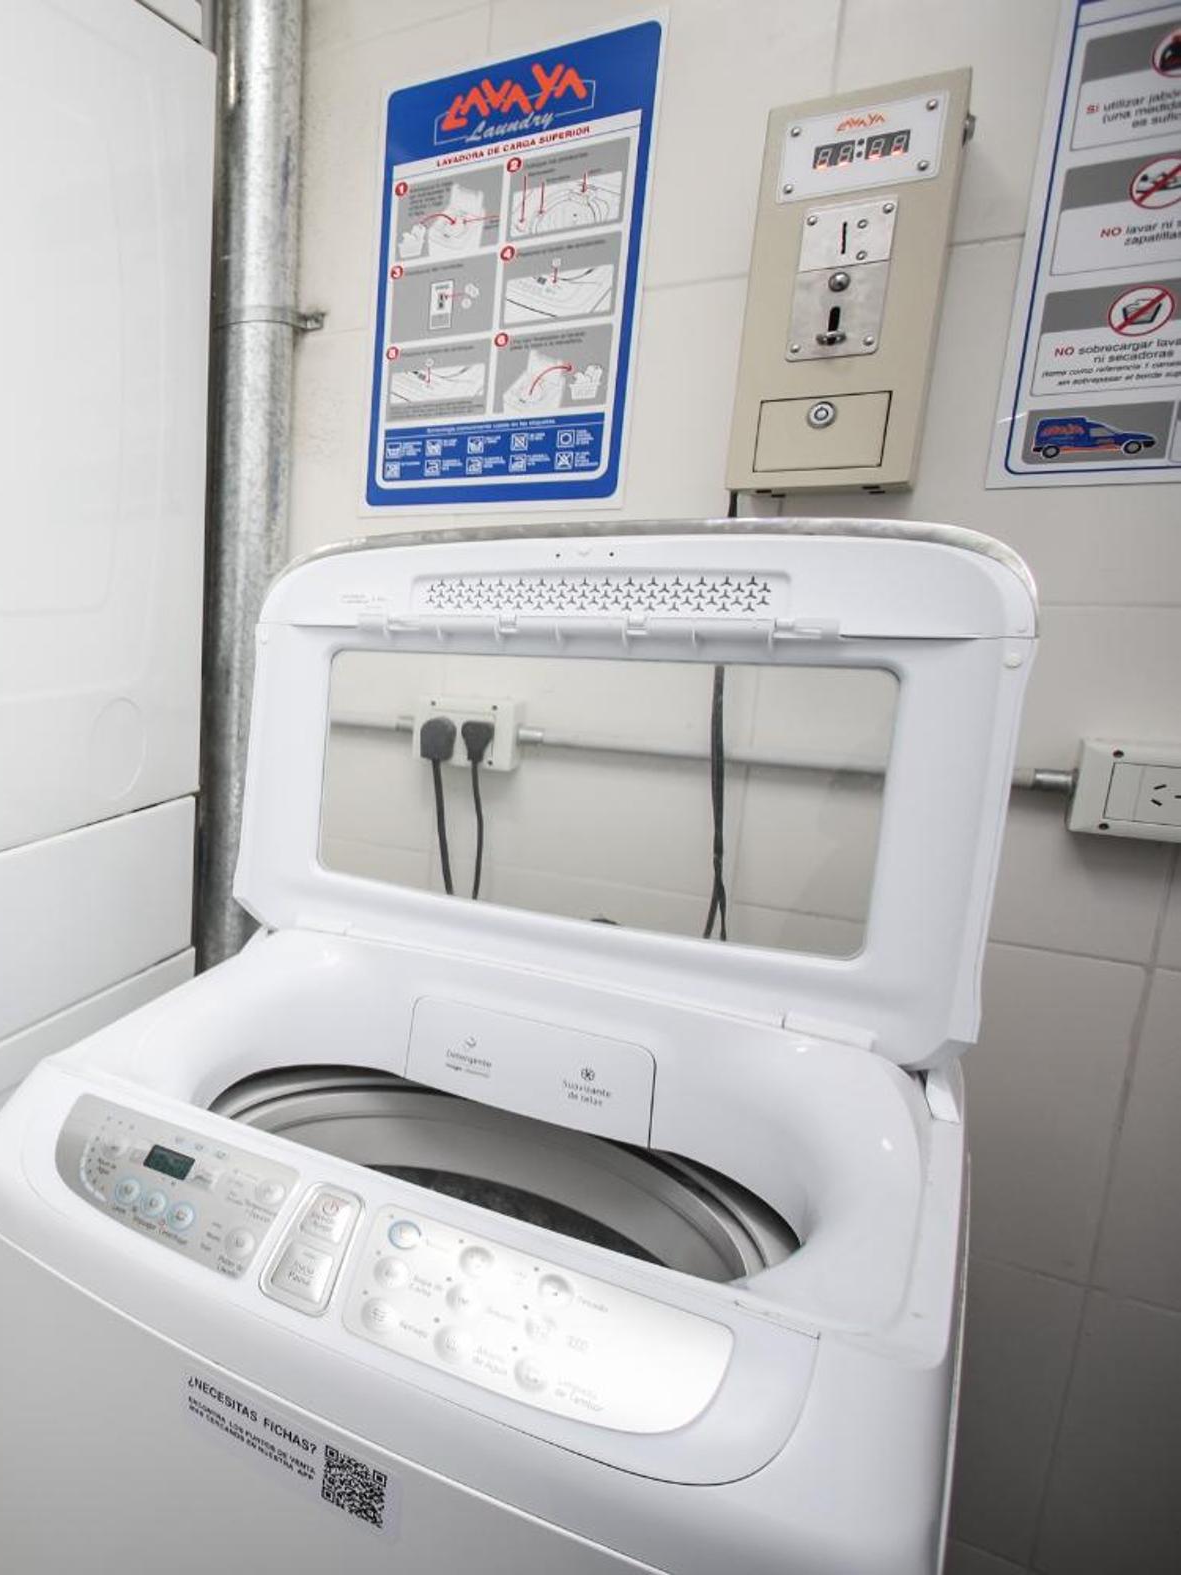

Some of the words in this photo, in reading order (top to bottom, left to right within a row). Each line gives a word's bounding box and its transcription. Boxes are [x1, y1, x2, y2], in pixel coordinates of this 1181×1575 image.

[1103, 96, 1145, 111] utilizar
[465, 111, 556, 143] Laundry
[436, 150, 484, 167] LAVADORA
[487, 145, 500, 155] DE
[503, 139, 537, 153] CARGA
[539, 125, 591, 144] SUPERIOR
[1100, 226, 1122, 238] NO
[1125, 222, 1157, 235] lavar
[1054, 345, 1075, 357] NO
[1078, 339, 1153, 355] sobrecargar
[1094, 354, 1105, 364] ni
[1107, 350, 1174, 363] secadoras
[446, 1049, 492, 1068] Detergente
[563, 1079, 612, 1098] Suavizante
[188, 1376, 258, 1422] ¿NECESITAS
[263, 1417, 317, 1454] FICHAS?
[245, 1430, 276, 1453] PUNTOS
[246, 1438, 257, 1449] EN
[258, 1444, 294, 1471] NUESTRA
